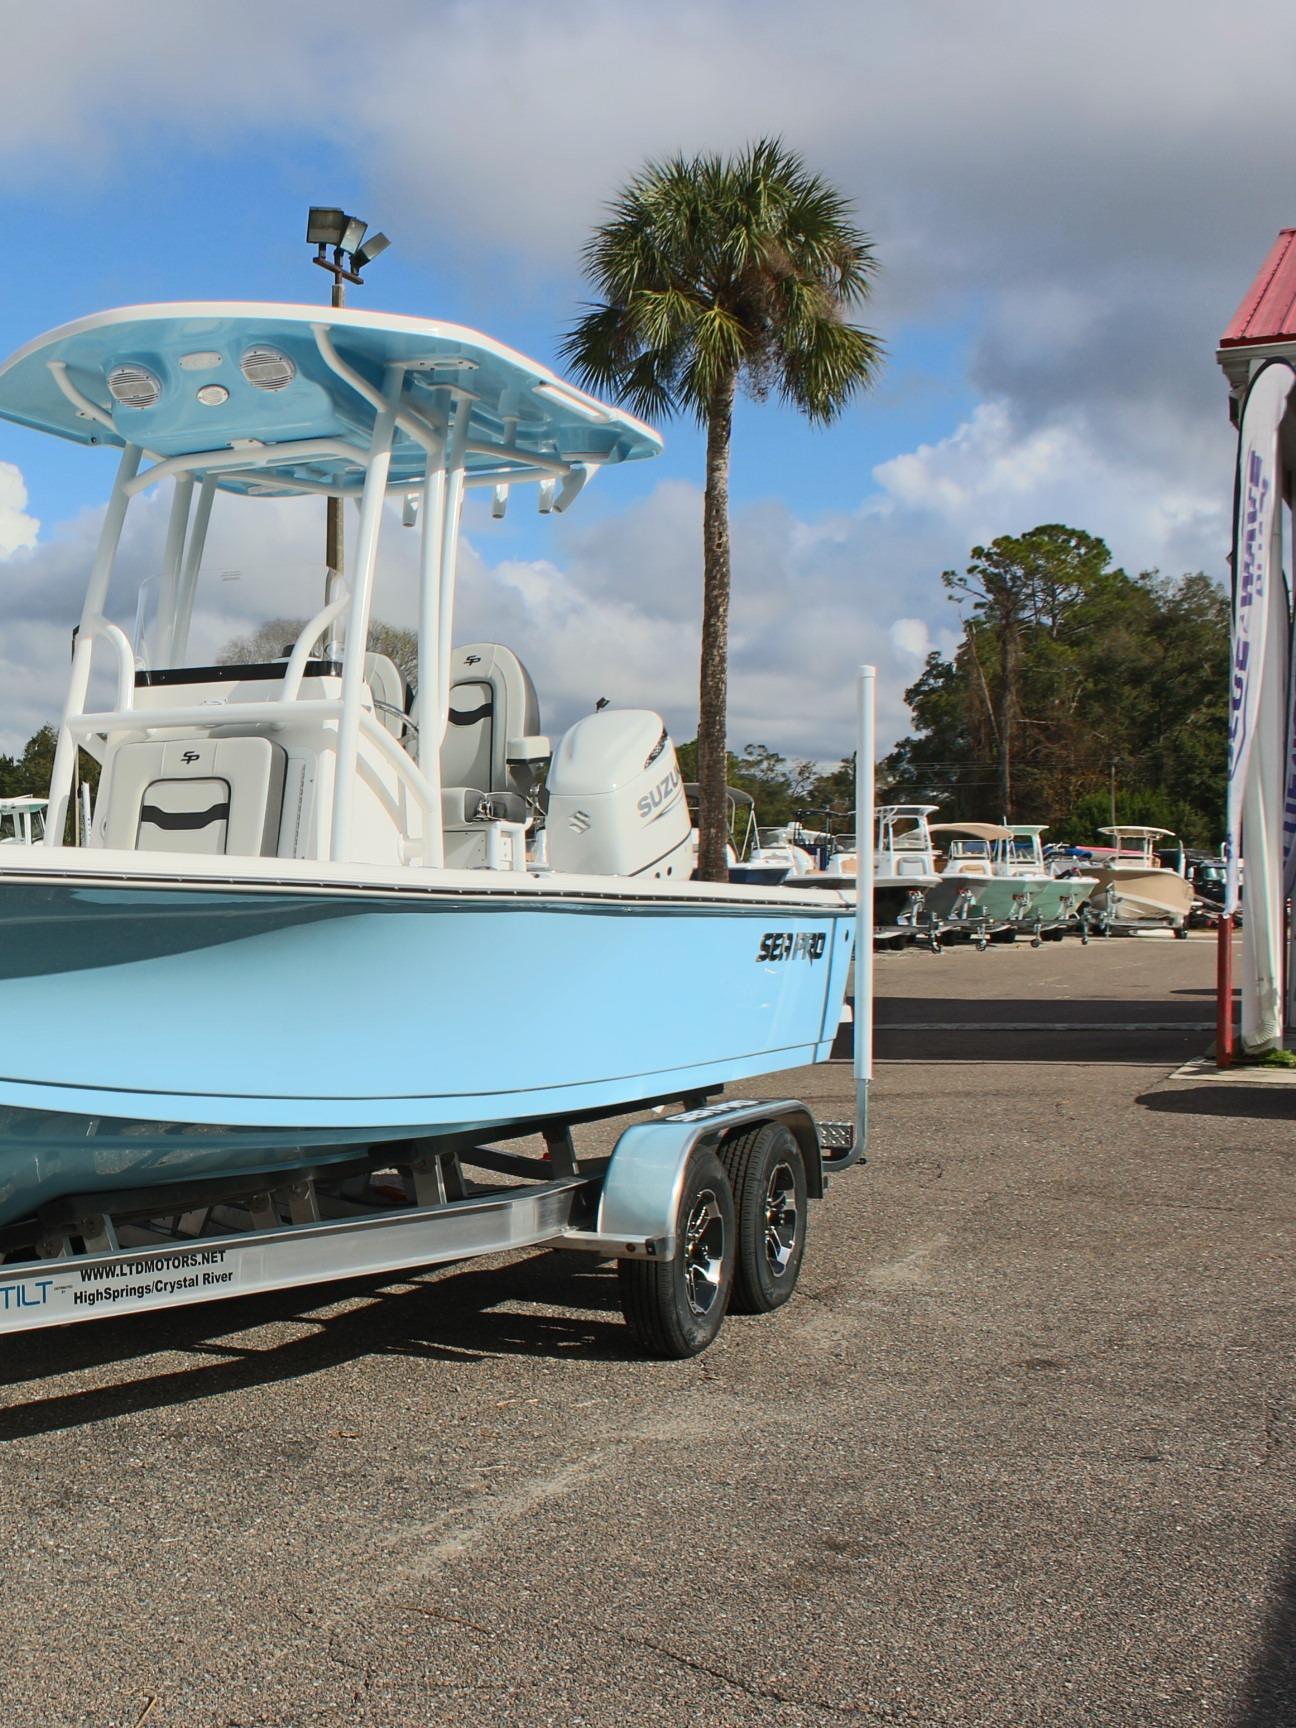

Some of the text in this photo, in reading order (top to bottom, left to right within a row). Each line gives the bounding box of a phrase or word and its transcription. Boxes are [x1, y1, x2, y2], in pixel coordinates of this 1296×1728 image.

[755, 932, 794, 962] SEA
[80, 1250, 226, 1282] WWW.LTDMOTORS.NET
[74, 1274, 199, 1305] HighSprings/Crystal
[202, 1271, 234, 1286] River
